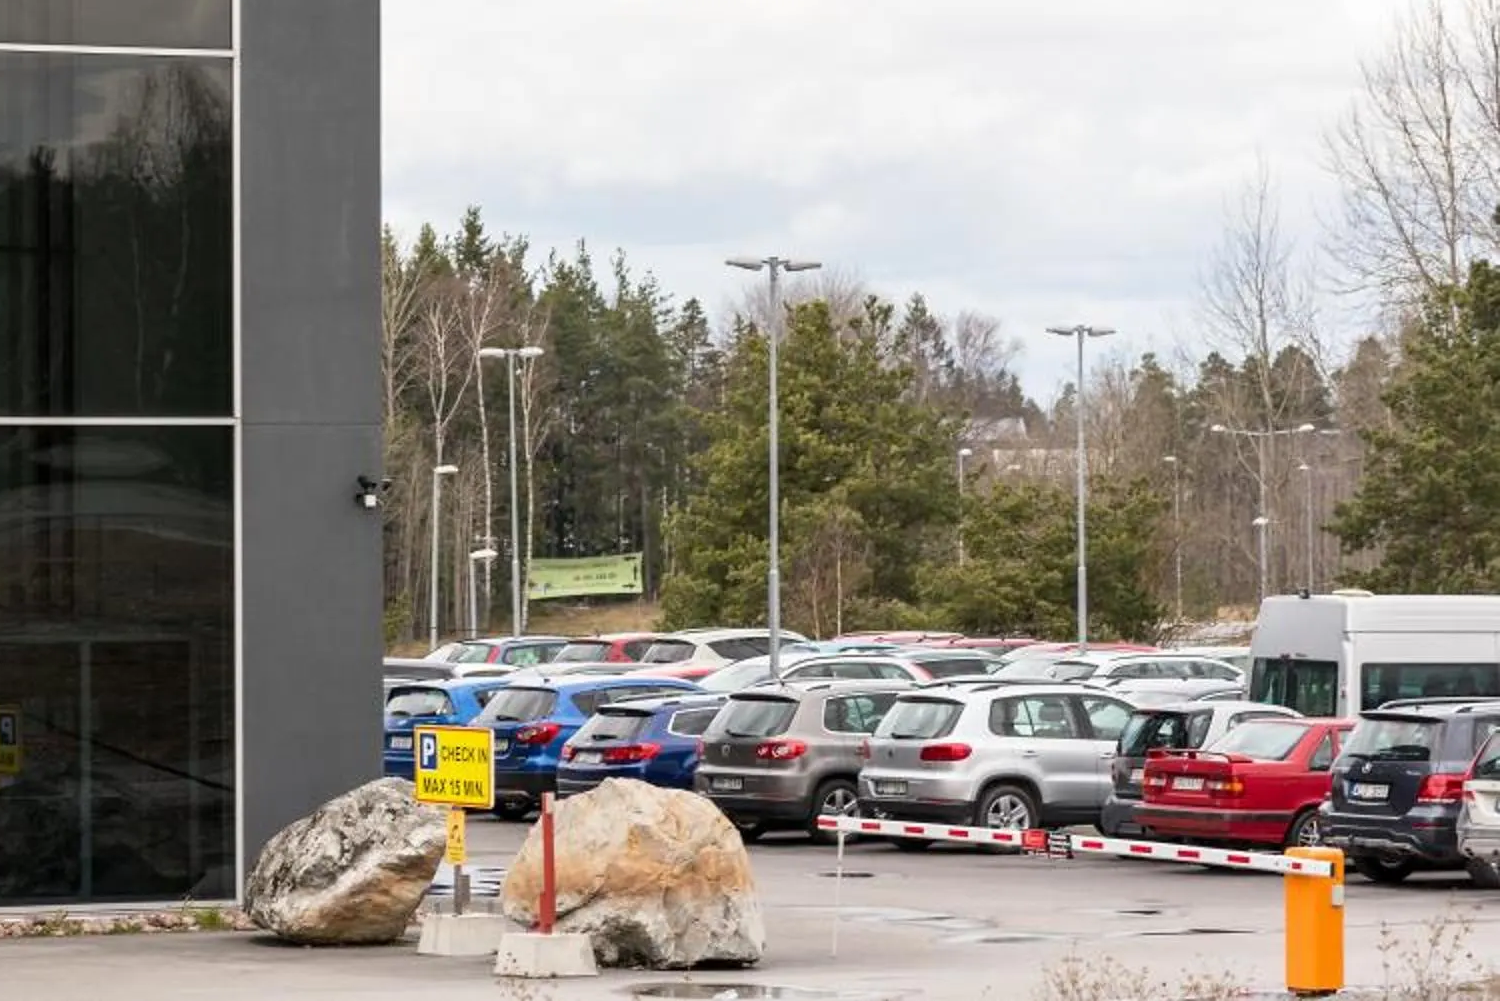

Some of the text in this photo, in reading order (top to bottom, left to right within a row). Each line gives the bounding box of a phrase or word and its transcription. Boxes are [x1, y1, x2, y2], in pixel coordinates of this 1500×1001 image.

[422, 736, 436, 766] P
[441, 745, 475, 763] CHECK
[478, 746, 489, 764] IN
[423, 777, 447, 795] MAX
[450, 778, 461, 796] 15
